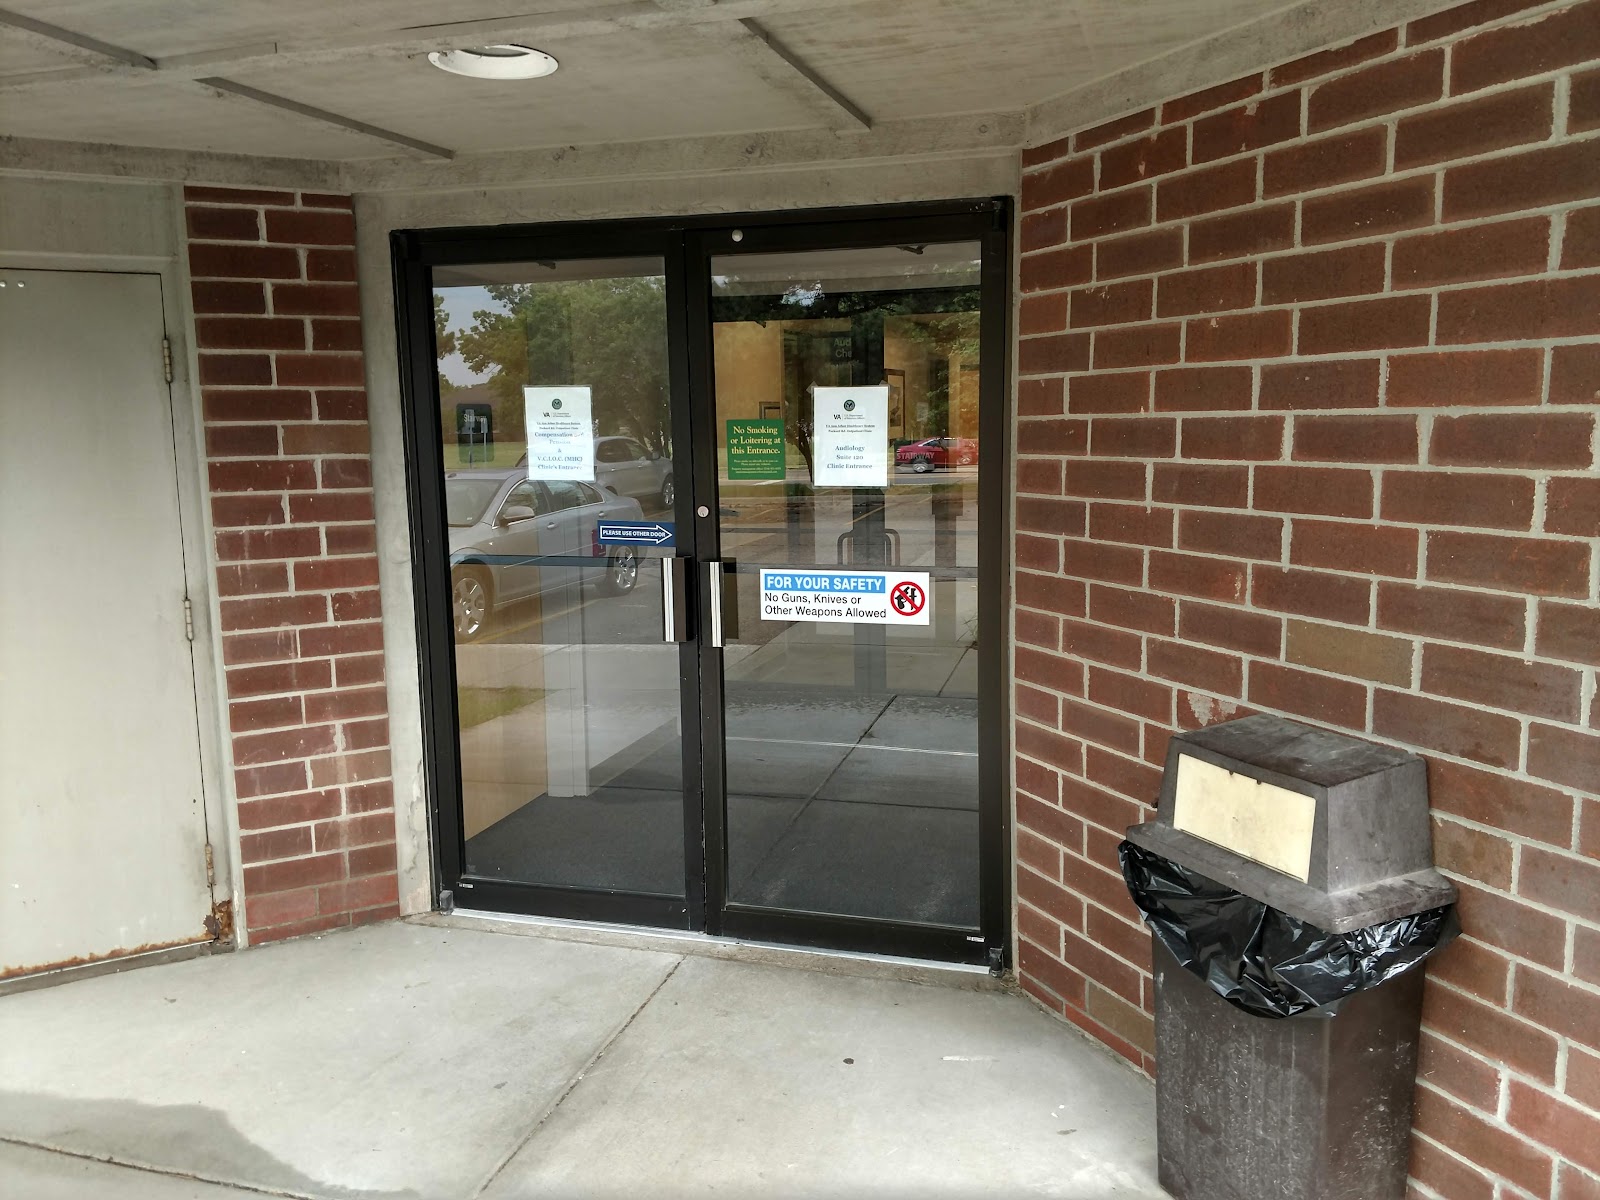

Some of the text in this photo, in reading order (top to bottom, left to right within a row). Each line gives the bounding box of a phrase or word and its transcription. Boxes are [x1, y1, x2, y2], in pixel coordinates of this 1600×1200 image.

[733, 425, 778, 435] No Smoking
[740, 436, 773, 445] Loitering
[731, 445, 781, 454] this Entrance.
[896, 452, 935, 460] STAIRWAY
[766, 576, 883, 591] FOR YOUR SAFETY
[764, 593, 862, 605] No Guns, Knives or
[764, 605, 887, 619] Other Weapons Allowed
